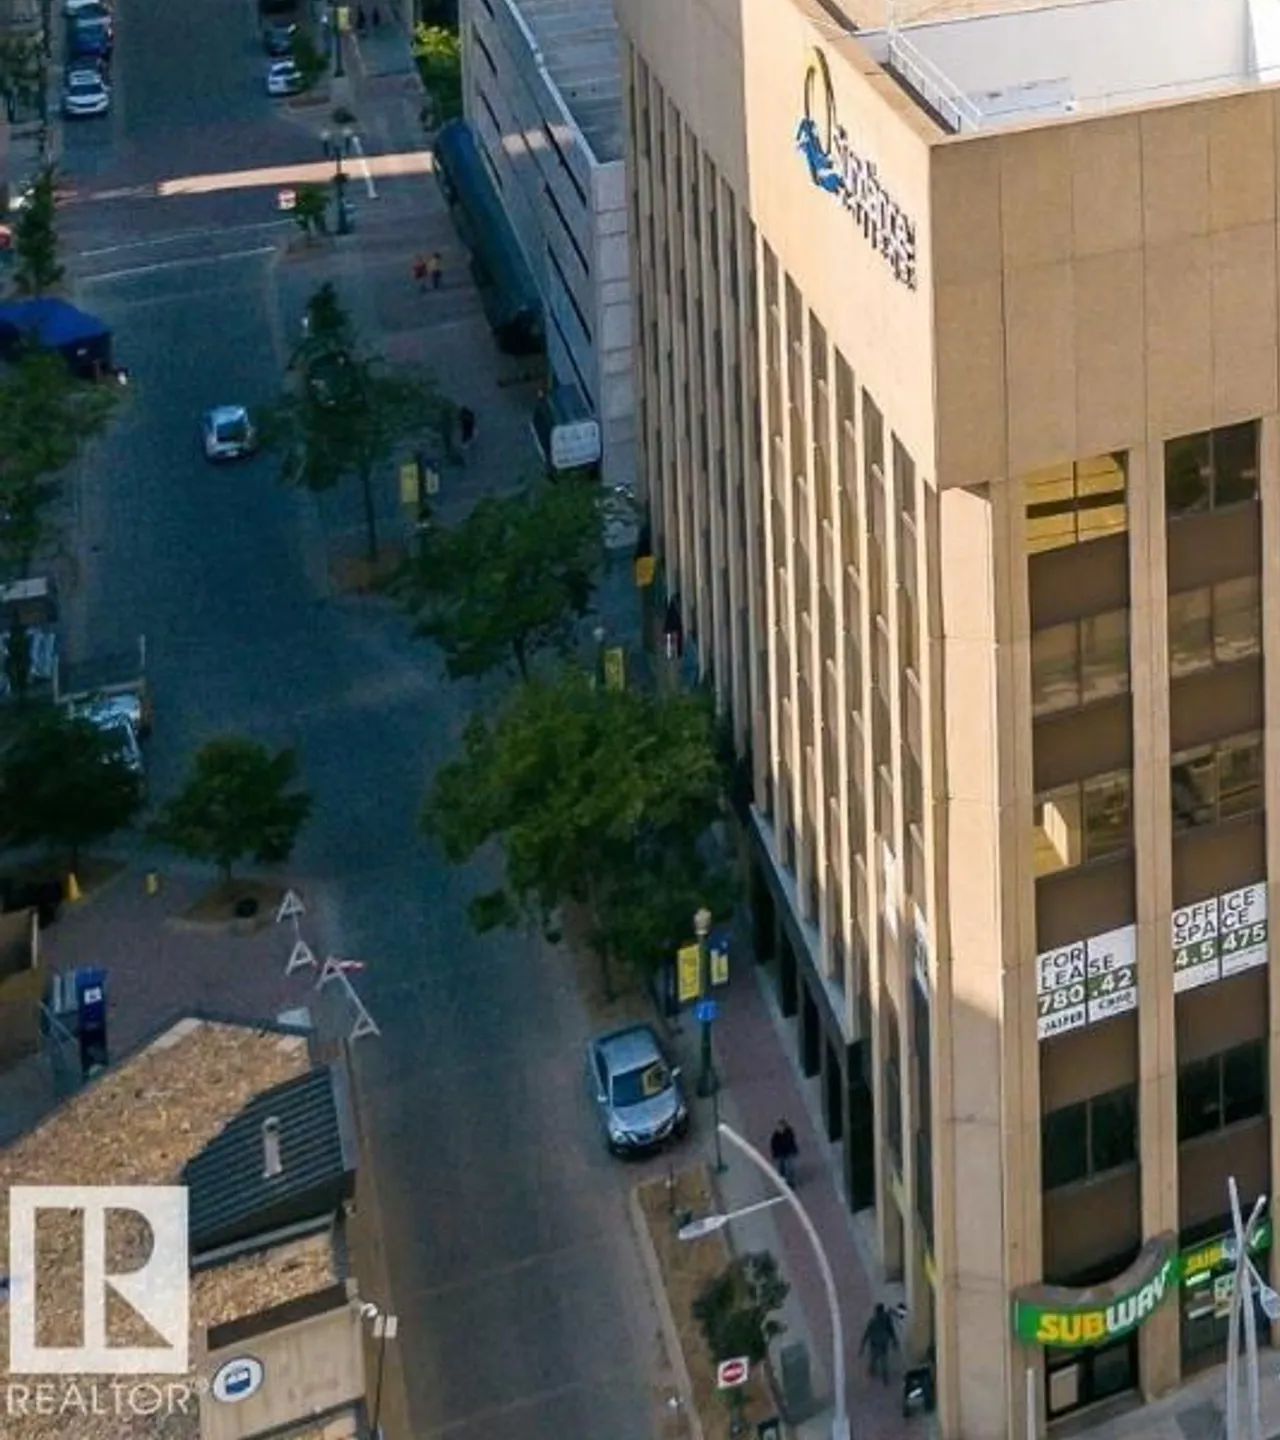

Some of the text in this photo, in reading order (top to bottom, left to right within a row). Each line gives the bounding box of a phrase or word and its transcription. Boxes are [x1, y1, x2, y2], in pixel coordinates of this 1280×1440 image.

[1174, 888, 1254, 928] OFFICE
[1175, 907, 1249, 945] SPACE
[1042, 948, 1083, 973] FOR
[1042, 953, 1114, 990] LEASE
[1037, 1260, 1171, 1344] SUBWAY
